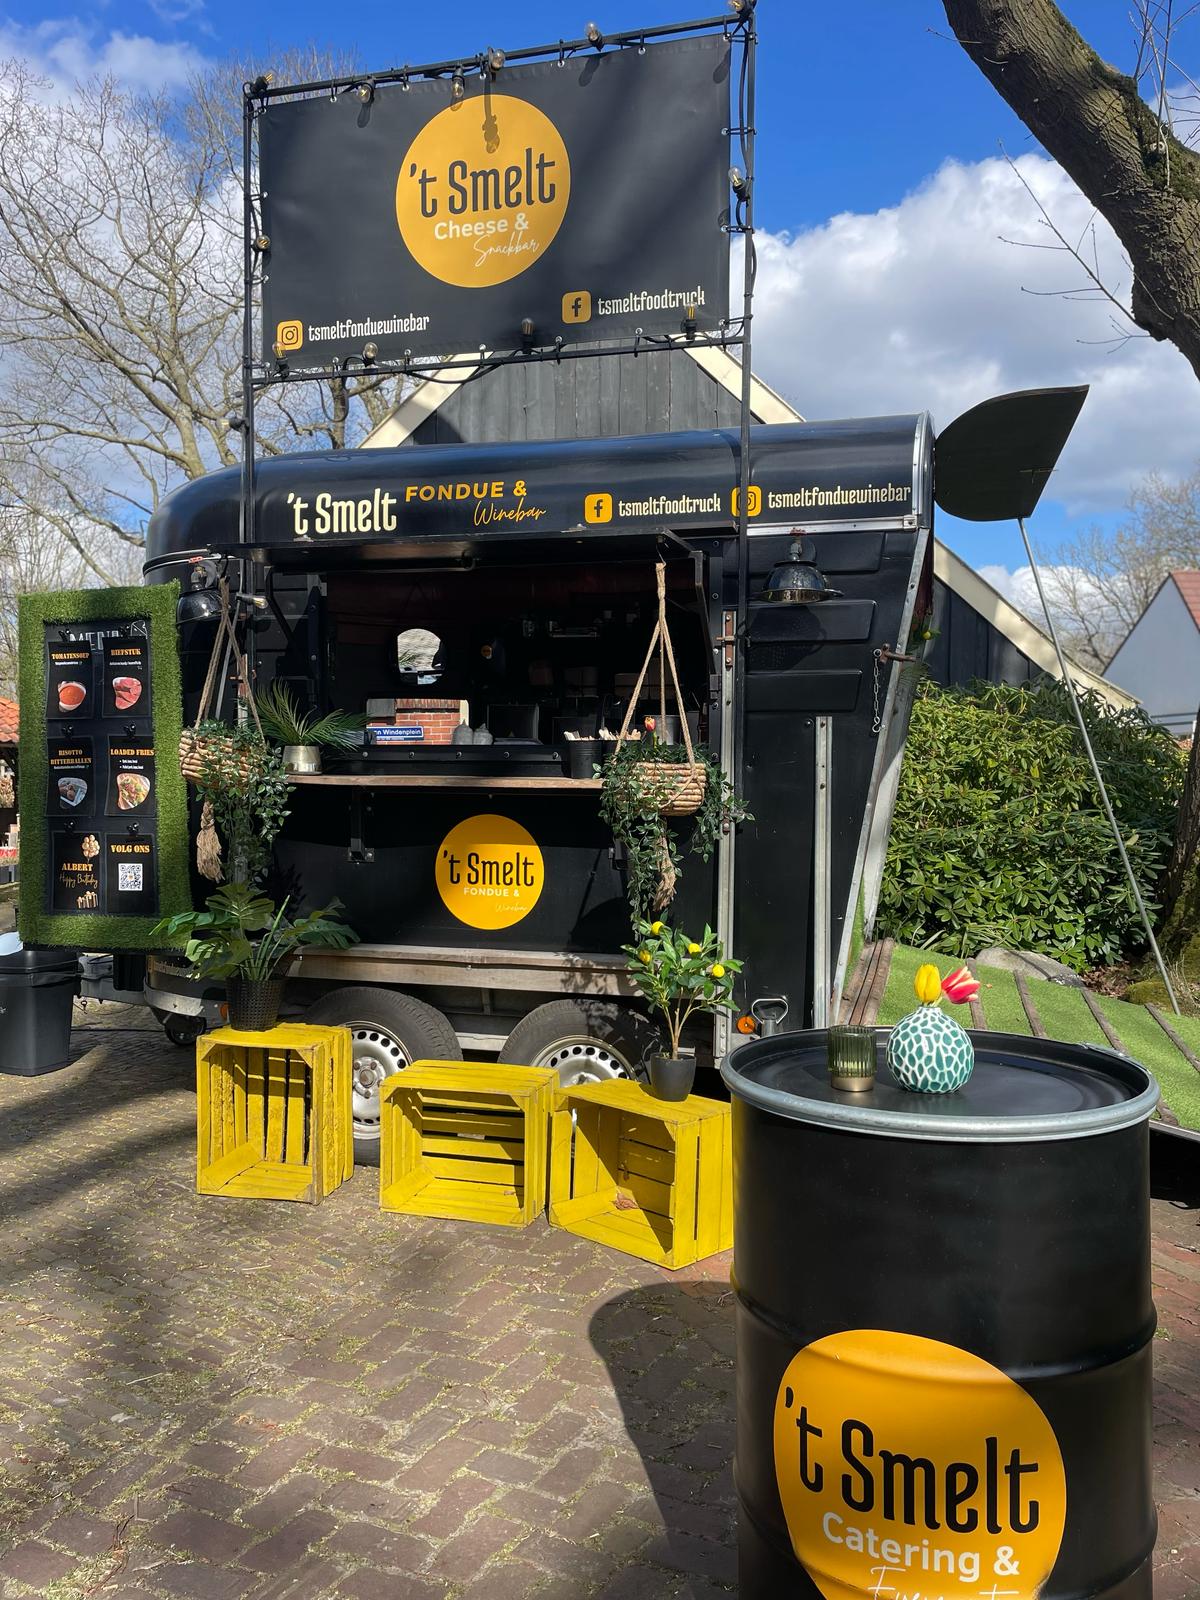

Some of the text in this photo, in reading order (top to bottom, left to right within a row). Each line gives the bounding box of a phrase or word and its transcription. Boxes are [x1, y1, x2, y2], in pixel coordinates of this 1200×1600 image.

[448, 147, 556, 215] Smelt
[434, 212, 529, 240] Cheese &
[473, 231, 540, 267] Snackbar
[597, 286, 706, 315] tsmeltfoodtruck
[308, 313, 430, 342] tsmeltfonduewinebar
[405, 480, 528, 502] FONDUE &
[618, 482, 912, 517] tsmeltfoodtruck tsmeltfonduewinebar
[315, 488, 397, 535] Smelt
[473, 497, 547, 526] Winebar
[110, 748, 155, 756] LOADED FRIES
[111, 844, 150, 853] VOLG ONS
[62, 863, 93, 872] ALBERT
[467, 852, 534, 887] Smelt
[463, 887, 521, 898] FONDUE &
[841, 1419, 1040, 1535] Smelt
[822, 1511, 981, 1583] Catering
[993, 1545, 1020, 1576] &
